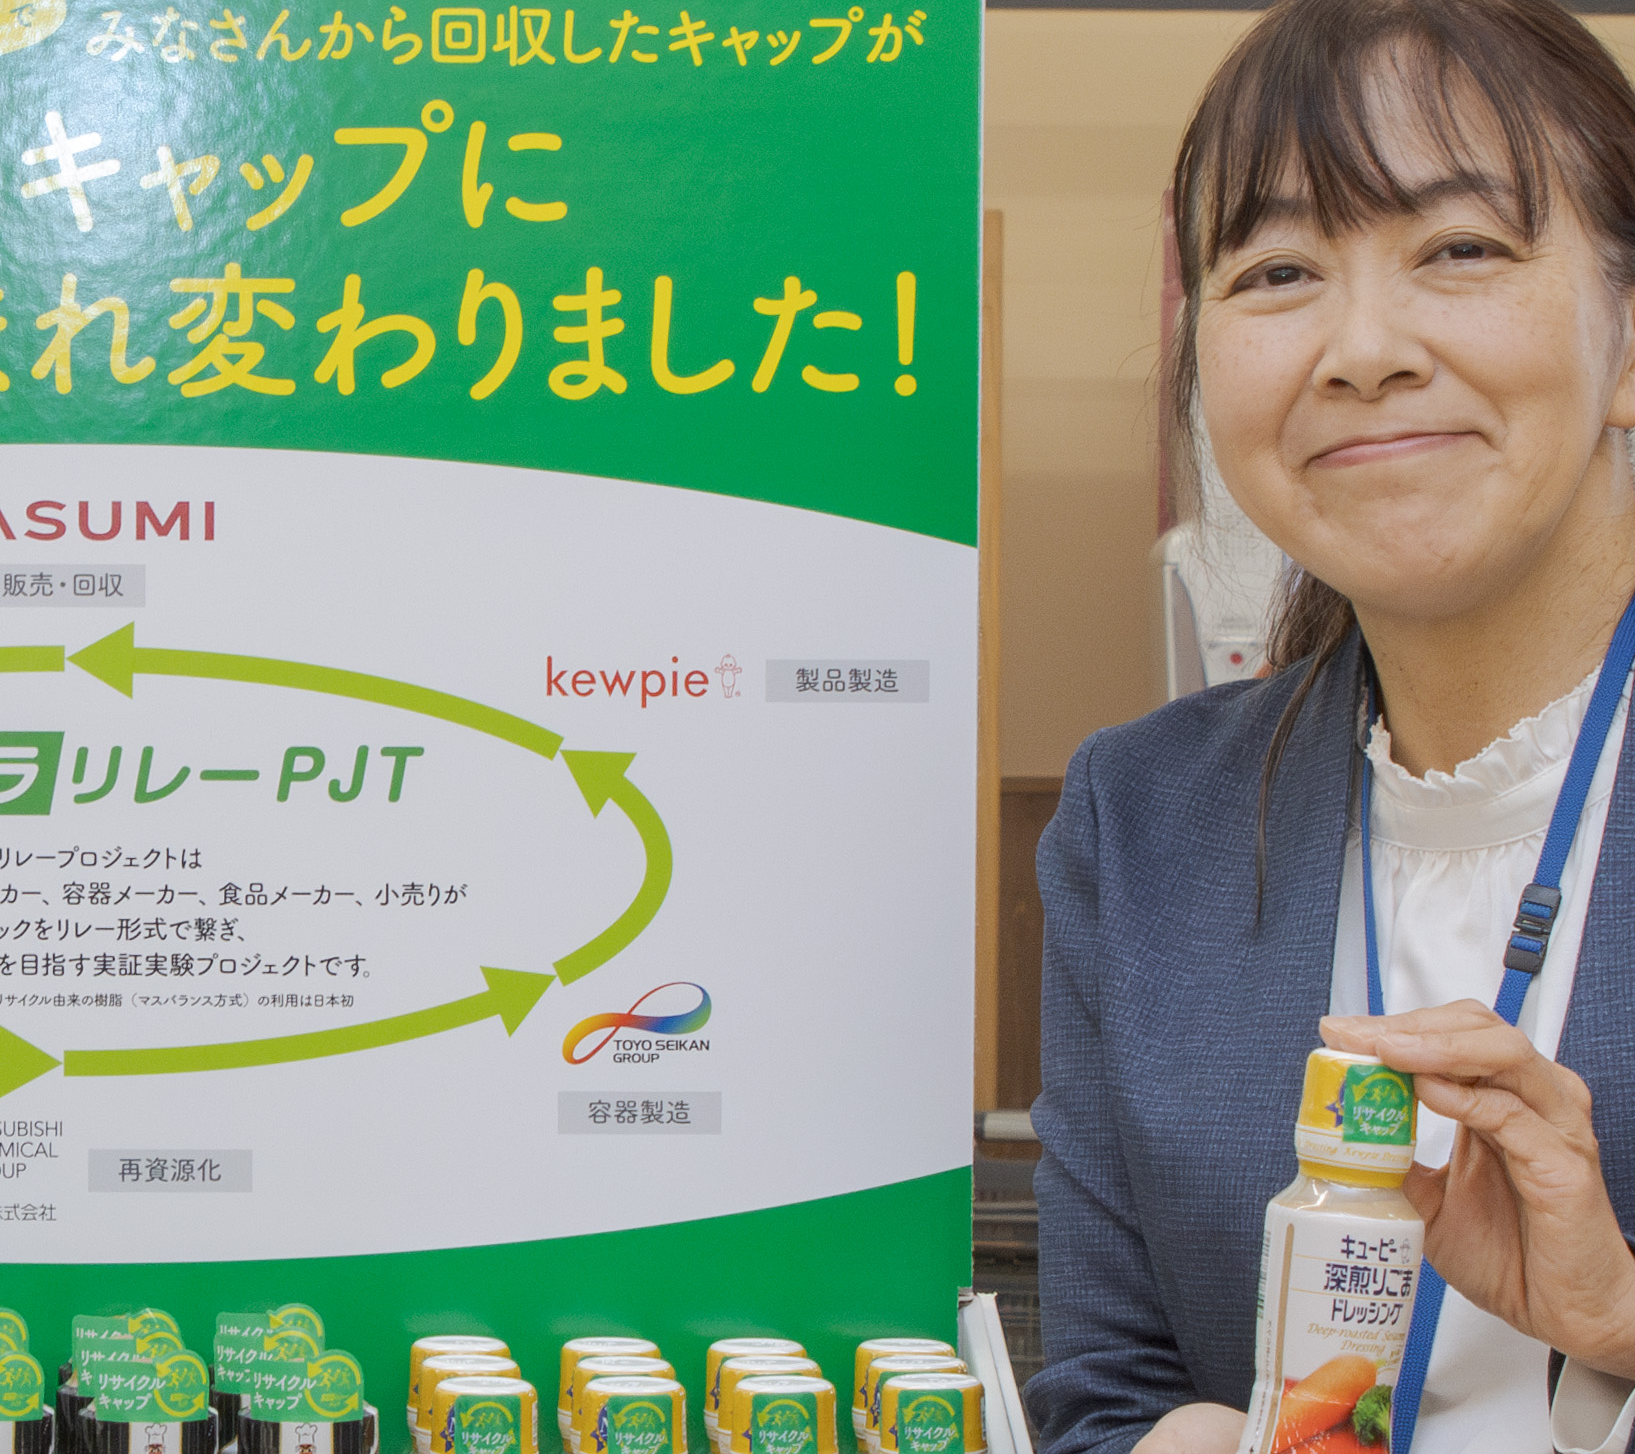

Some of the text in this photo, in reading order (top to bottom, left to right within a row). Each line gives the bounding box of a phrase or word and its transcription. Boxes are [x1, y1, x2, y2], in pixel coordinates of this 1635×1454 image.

[84, 9, 926, 65] みなさんから回収したキャップが
[2, 572, 124, 599] 販売・回収
[545, 655, 710, 708] kewpie
[795, 666, 900, 695] 製品製造
[612, 1038, 711, 1052] TOYO SEIKAN
[612, 1052, 660, 1065] GROUP
[587, 1099, 692, 1126] 容器製造
[117, 1157, 223, 1184] 再資源化
[1340, 1234, 1397, 1262] キューピー
[1323, 1262, 1413, 1297] 深煎りごま
[1331, 1298, 1403, 1325] ドレッシング
